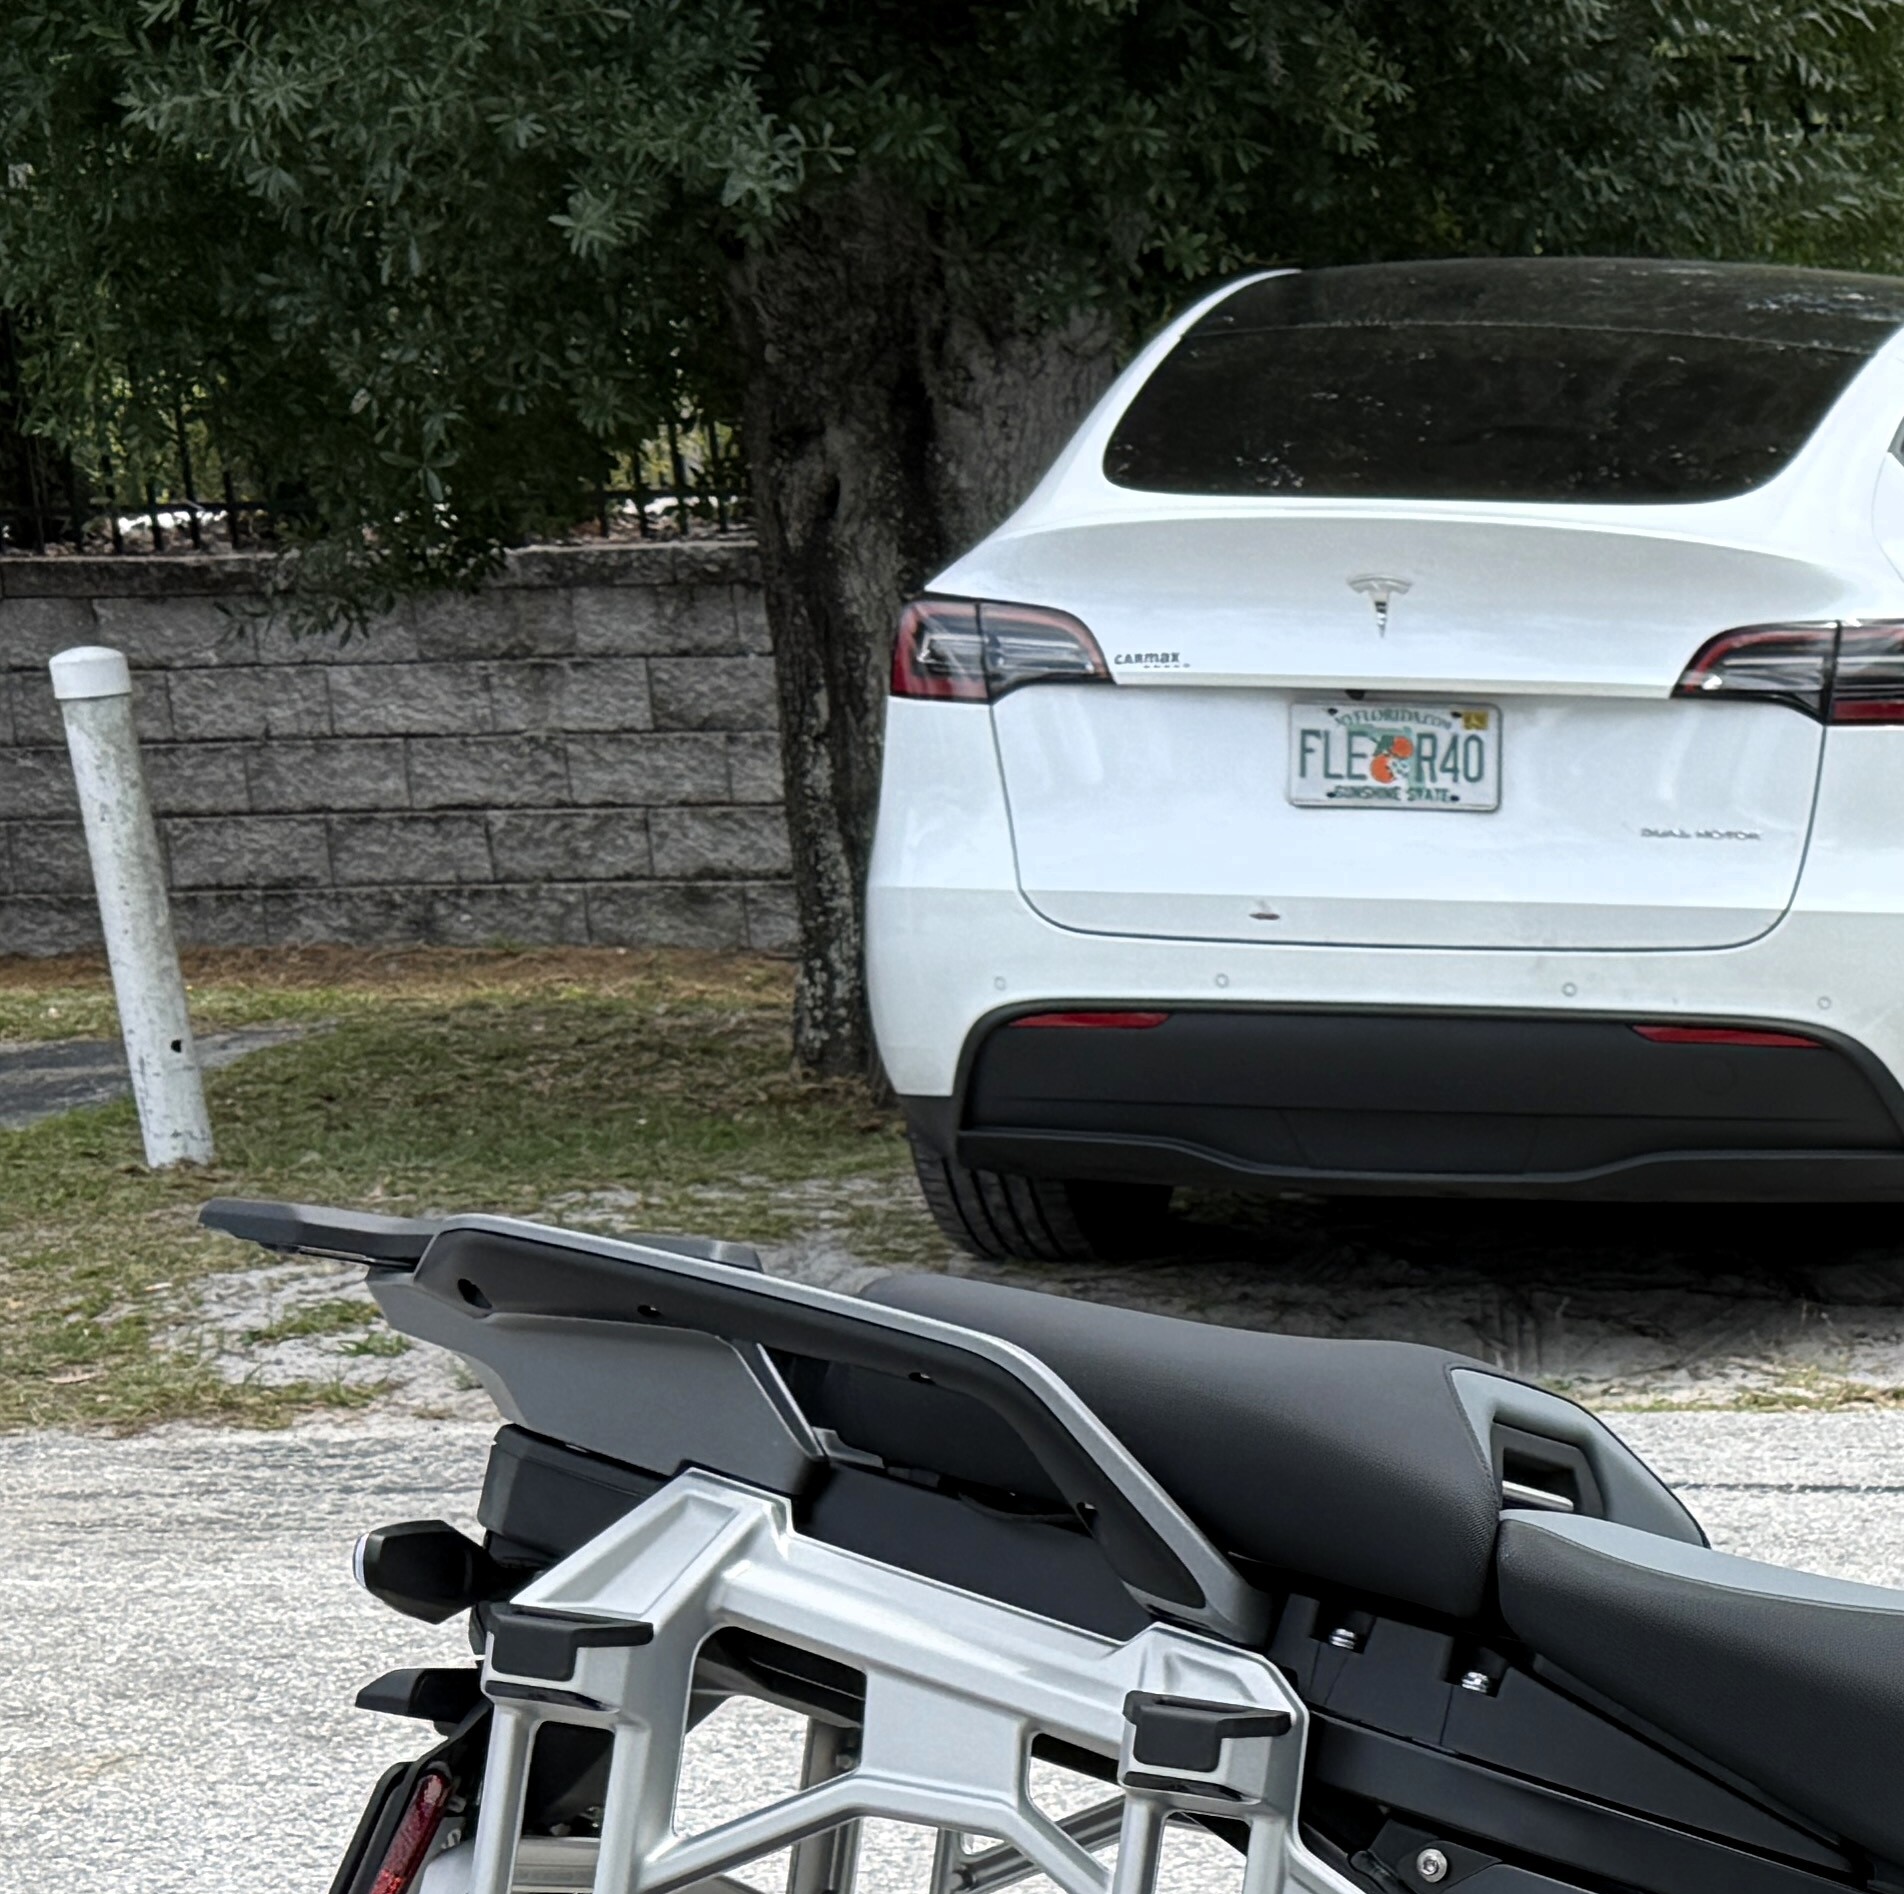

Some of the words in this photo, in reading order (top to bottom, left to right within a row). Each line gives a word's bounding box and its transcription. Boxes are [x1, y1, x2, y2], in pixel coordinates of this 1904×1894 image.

[1300, 728, 1369, 781] FLE
[1415, 732, 1485, 784] R40
[1334, 785, 1402, 801] SUNSHINE
[1407, 786, 1449, 802] STATE
